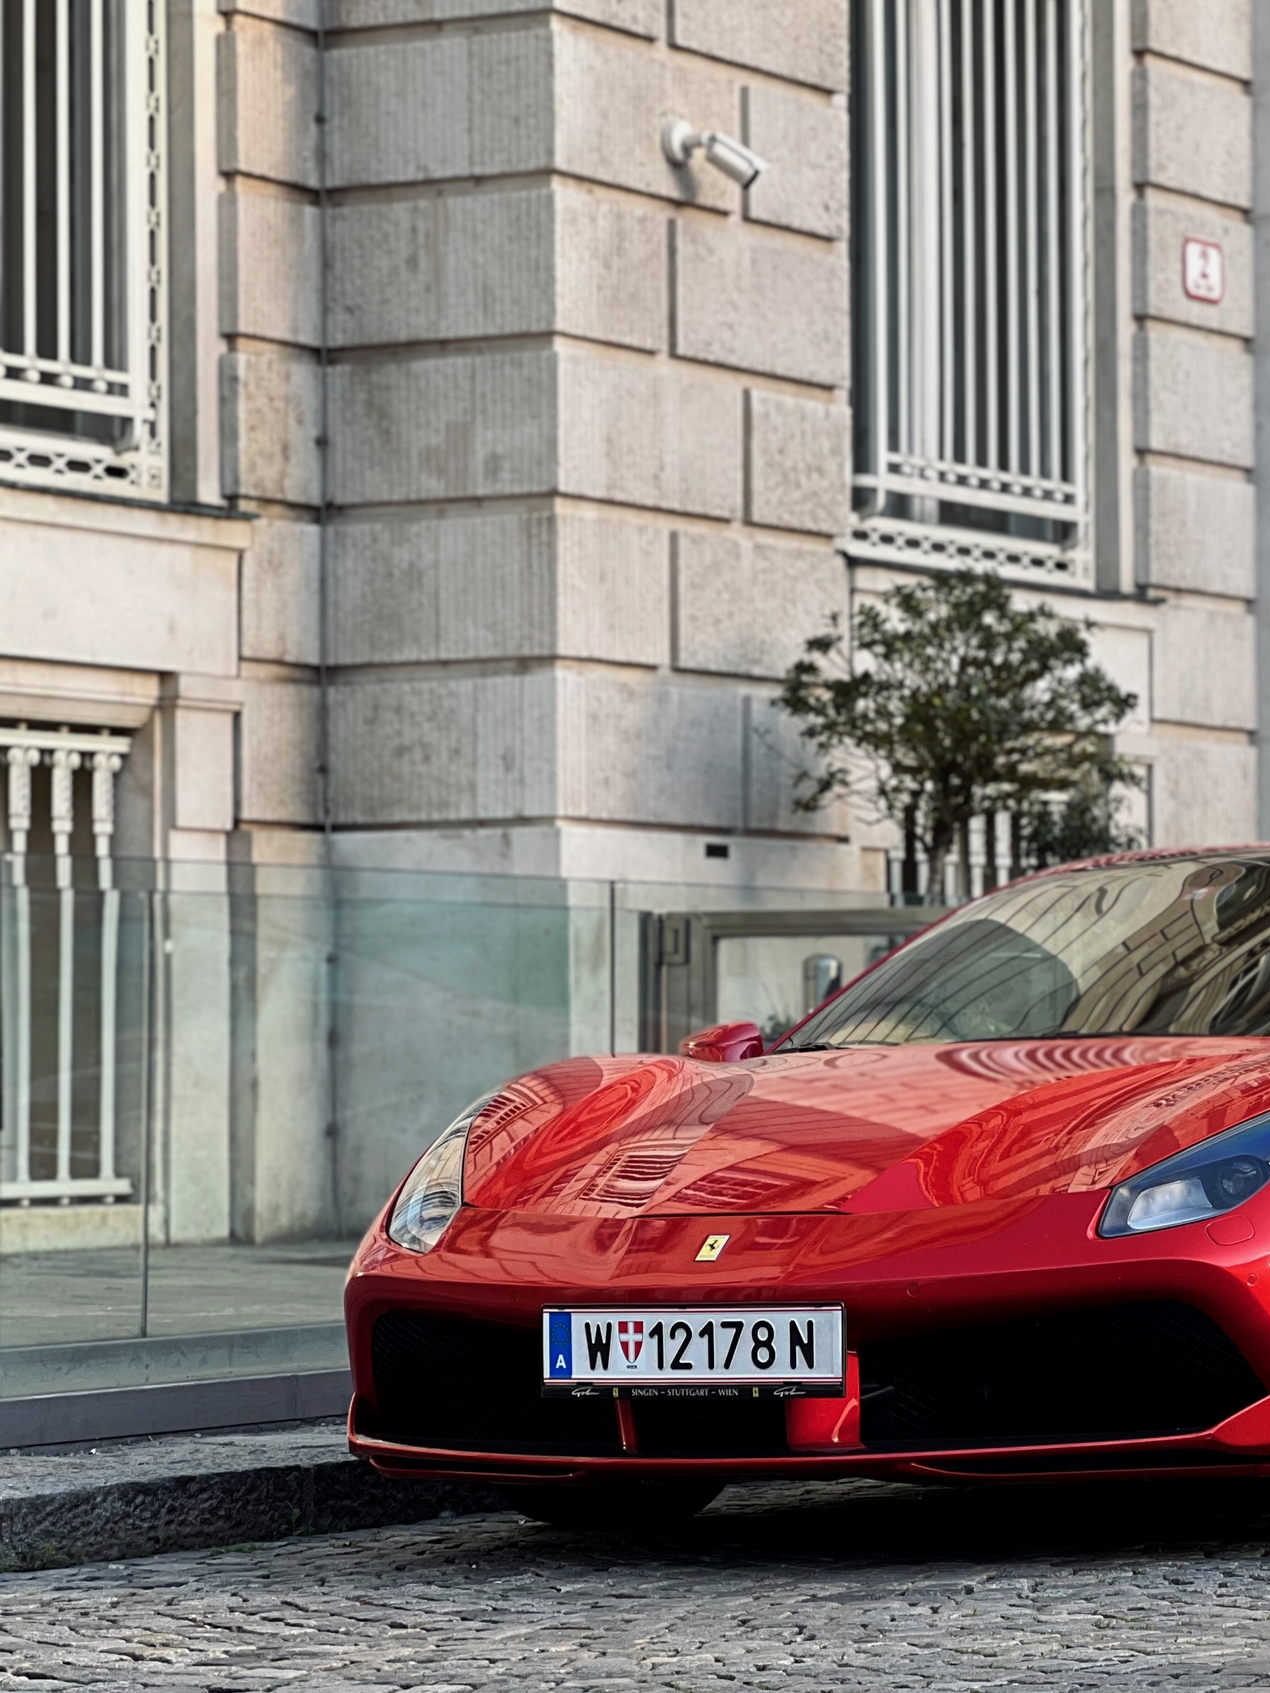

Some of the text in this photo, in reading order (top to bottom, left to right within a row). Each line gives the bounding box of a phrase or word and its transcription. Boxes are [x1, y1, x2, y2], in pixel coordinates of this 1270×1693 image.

[584, 1319, 816, 1371] W 12178 N
[555, 1354, 567, 1369] A
[631, 1388, 739, 1397] SINGEN STUTTGART WIEN
